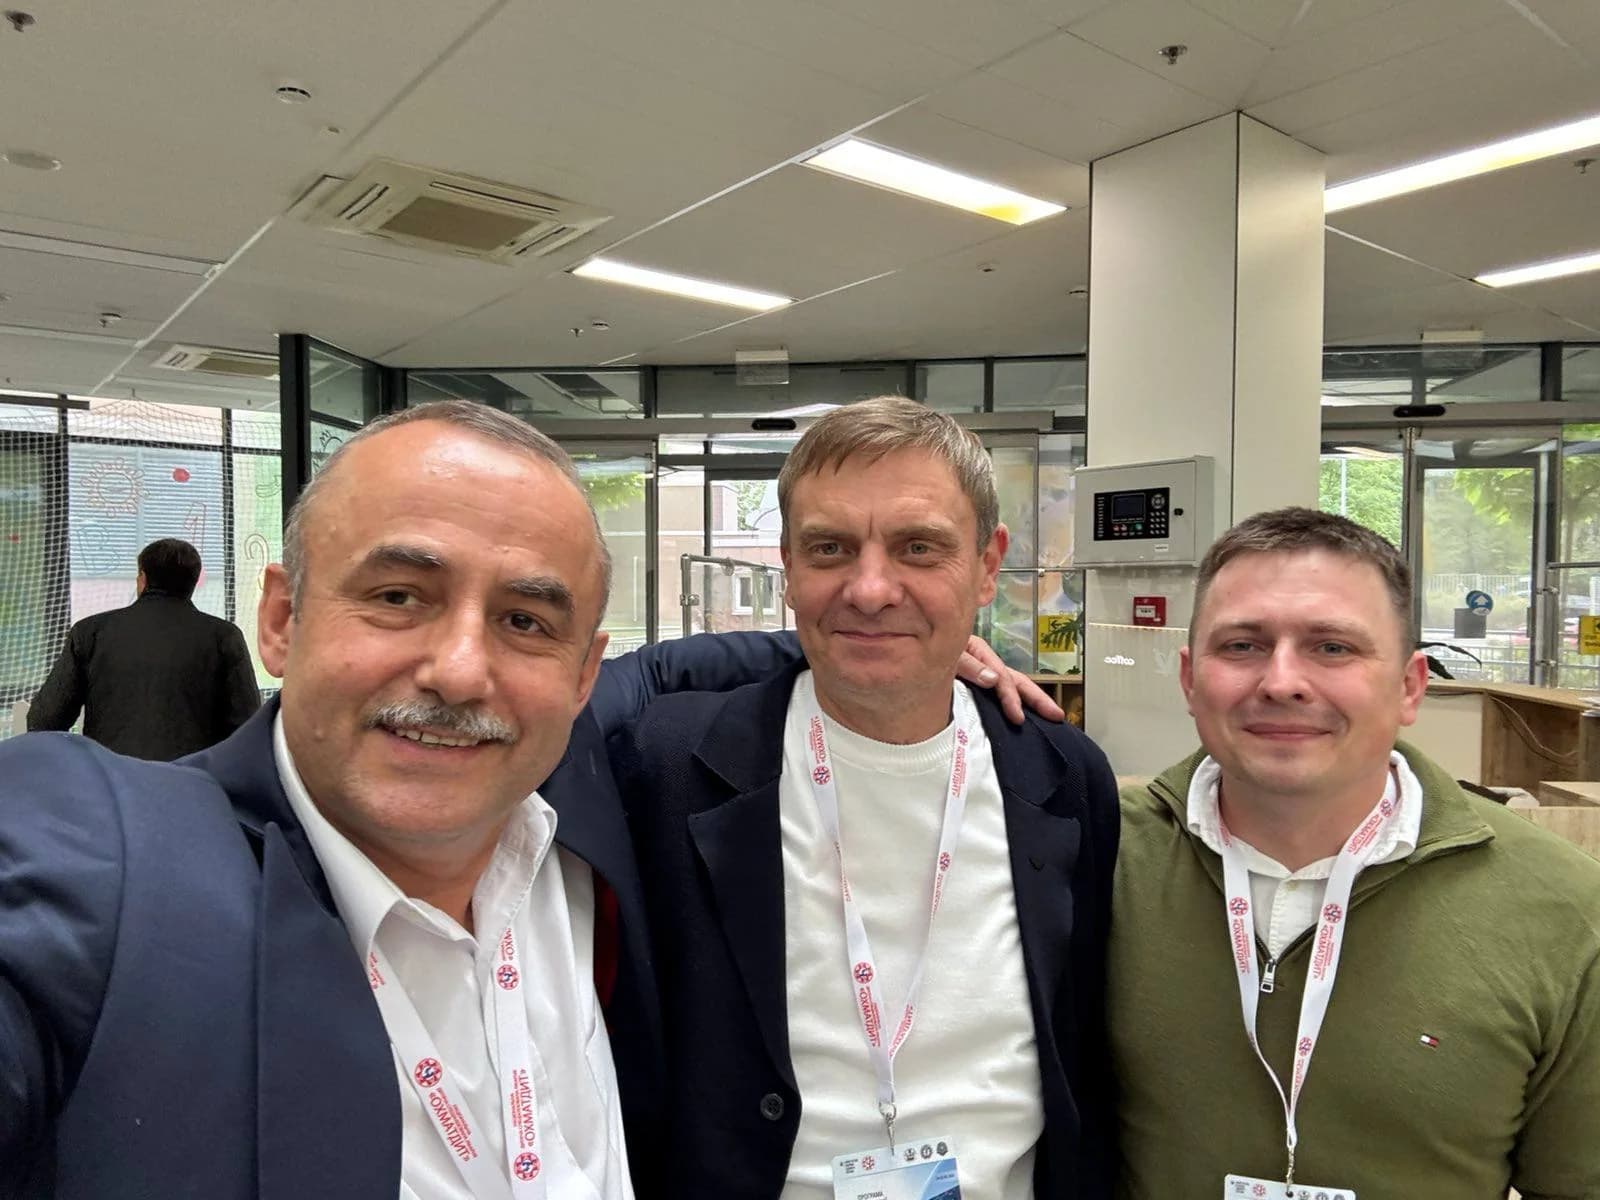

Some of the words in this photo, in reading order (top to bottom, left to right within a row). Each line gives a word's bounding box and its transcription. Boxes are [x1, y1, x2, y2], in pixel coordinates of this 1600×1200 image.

[859, 987, 877, 1048] «ОХМАТДИТ»
[429, 1091, 471, 1162] «ОХМАТДИТ»
[518, 1068, 536, 1148] «ОХМАТДИТ»
